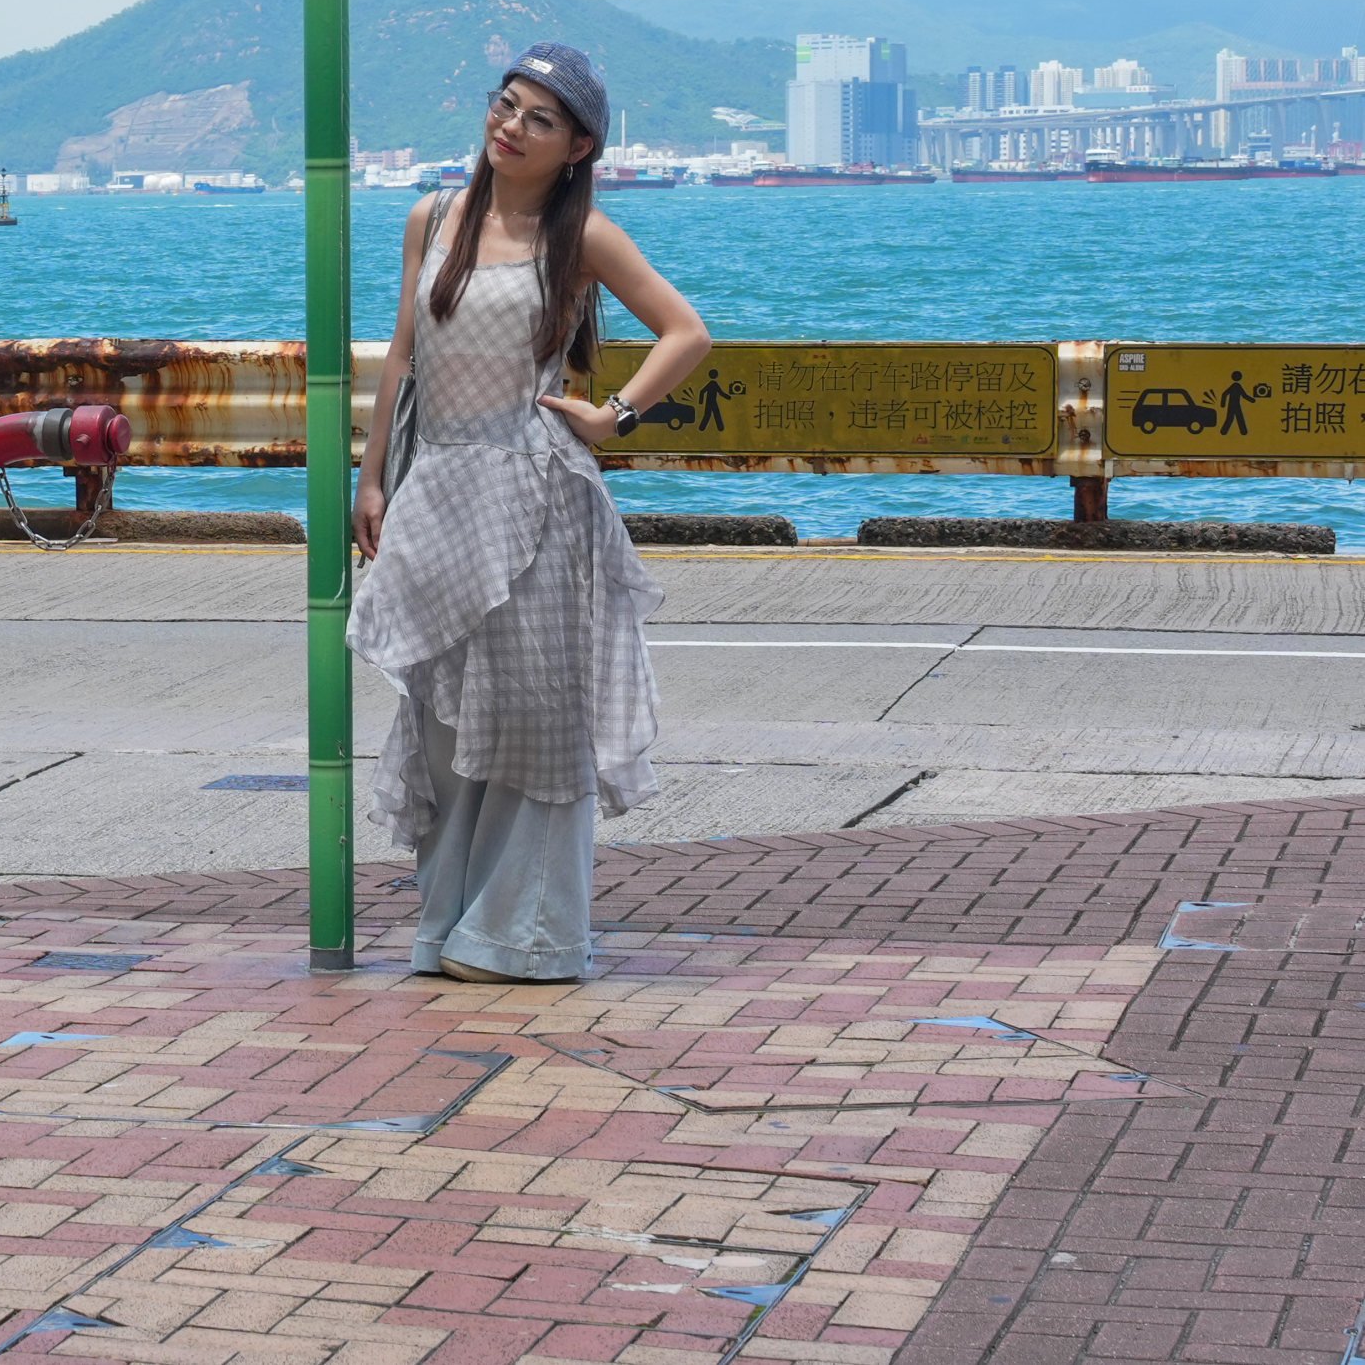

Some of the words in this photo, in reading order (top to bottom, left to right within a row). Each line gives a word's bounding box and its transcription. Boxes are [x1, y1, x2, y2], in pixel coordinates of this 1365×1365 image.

[1119, 353, 1145, 364] ASPIRE
[754, 361, 1037, 393] 请勿在行车路停留及
[753, 399, 1038, 431] 拍照，违者可被检控
